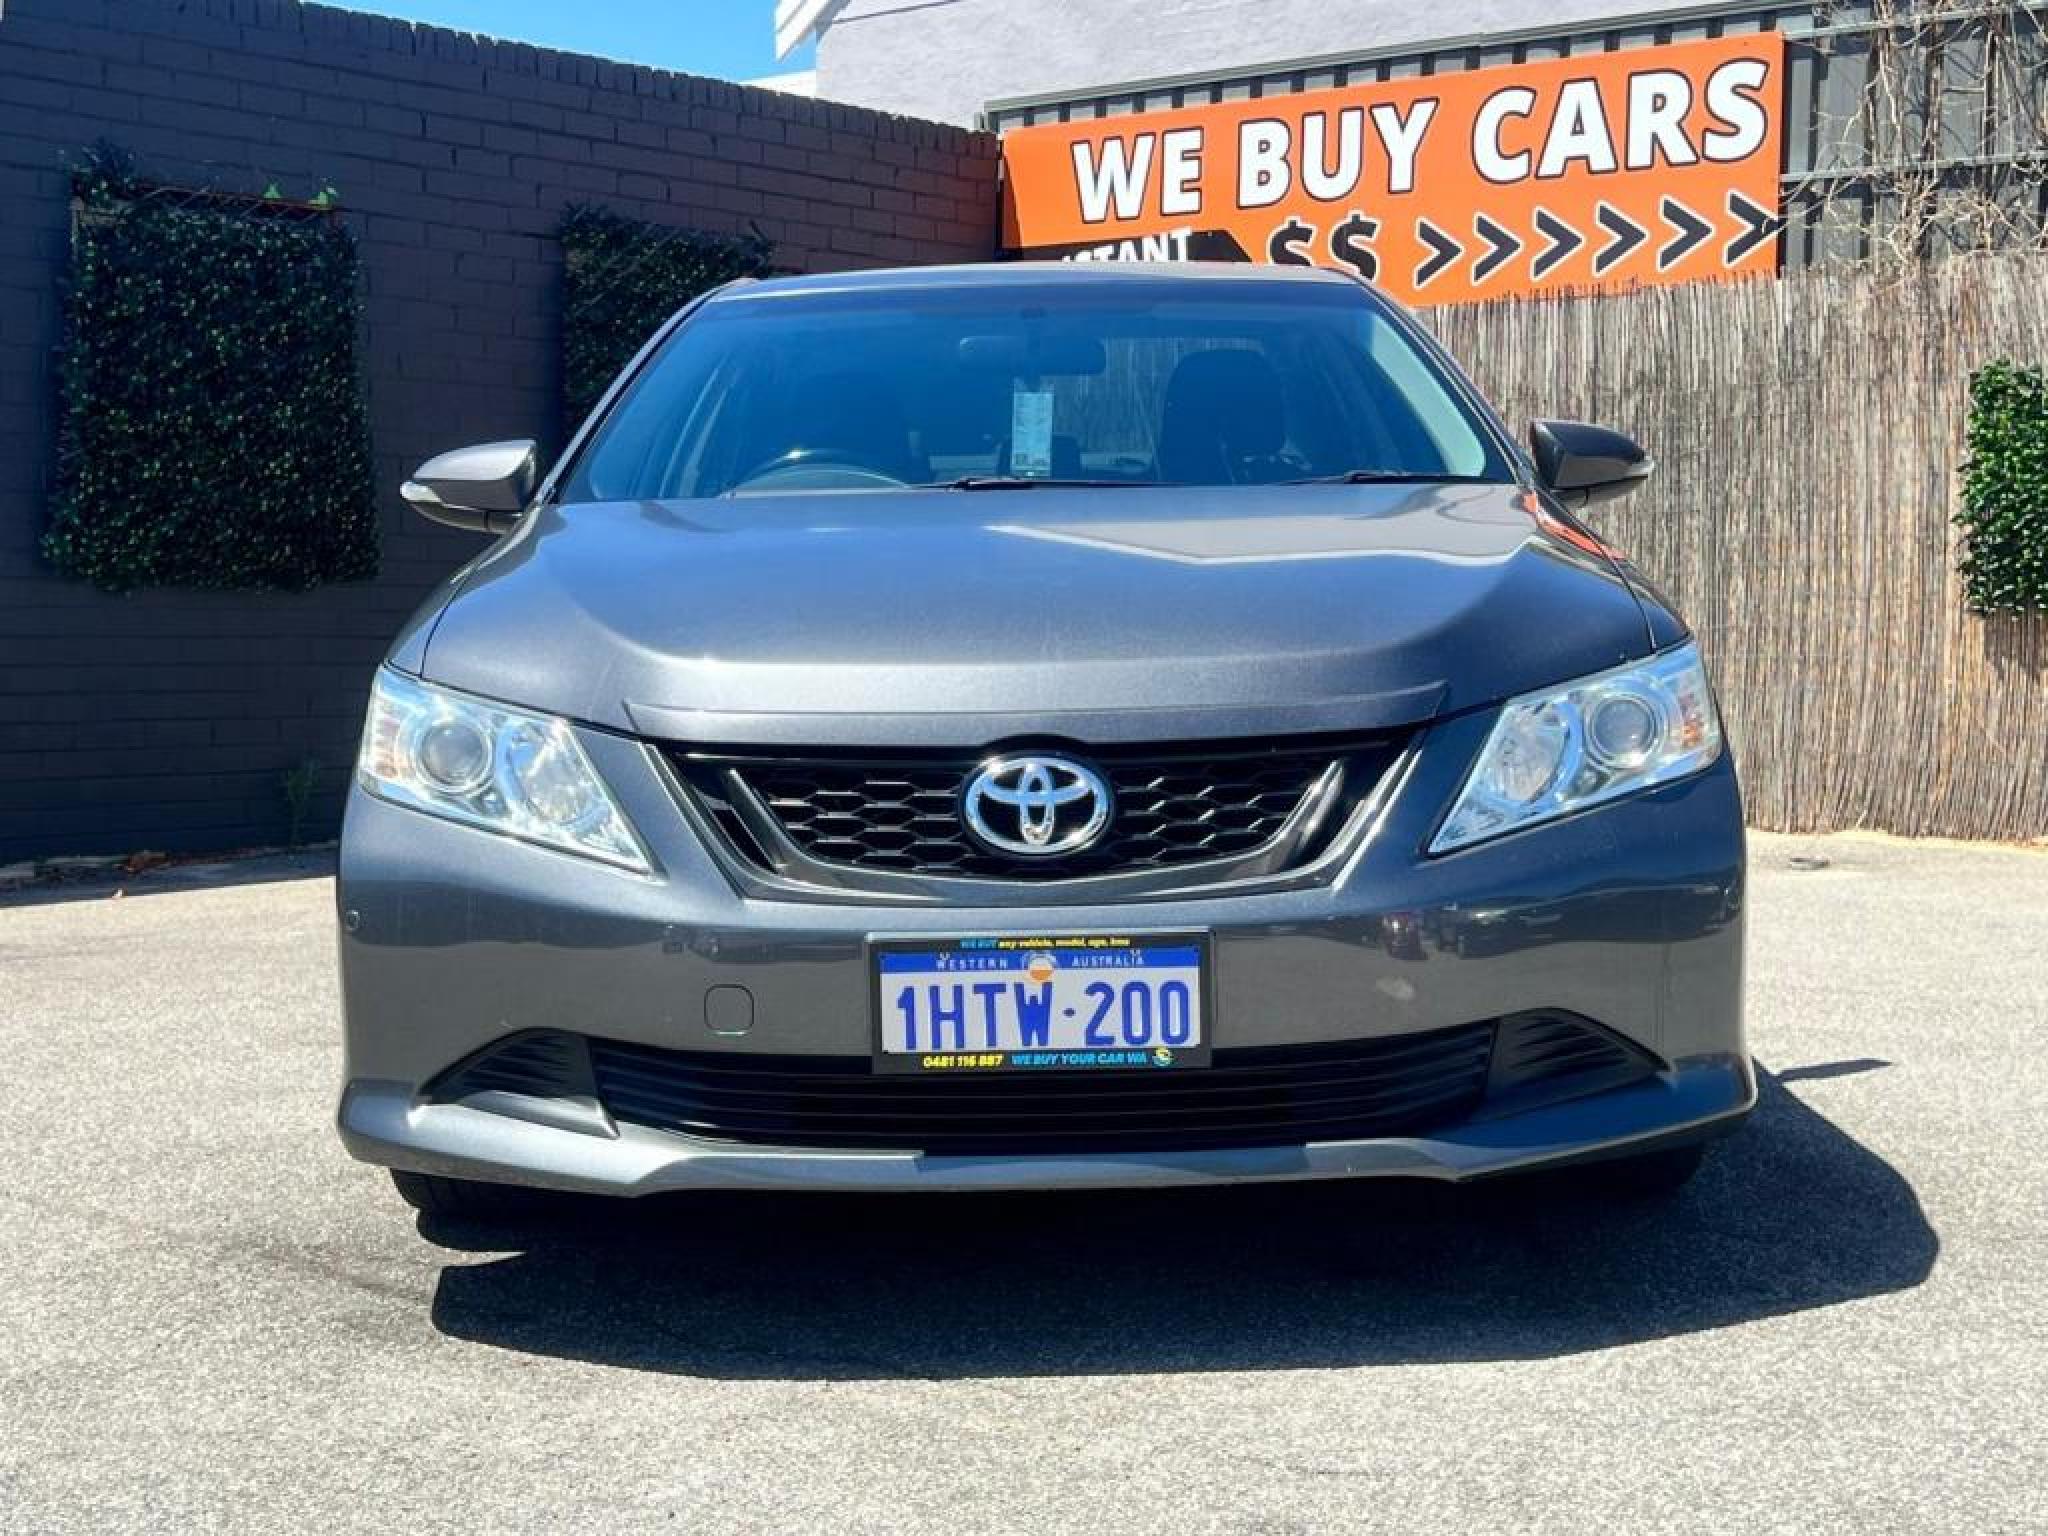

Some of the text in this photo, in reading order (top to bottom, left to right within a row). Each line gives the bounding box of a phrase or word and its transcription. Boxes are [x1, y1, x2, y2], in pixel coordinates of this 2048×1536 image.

[1070, 57, 1769, 224] WE BUY CARS
[936, 955, 1144, 970] WESTERN AUSTRALIA
[1011, 1054, 1031, 1065] WE
[1033, 1054, 1059, 1065] BUY
[1061, 1053, 1095, 1065] YOUR
[1098, 1053, 1123, 1064] CAR
